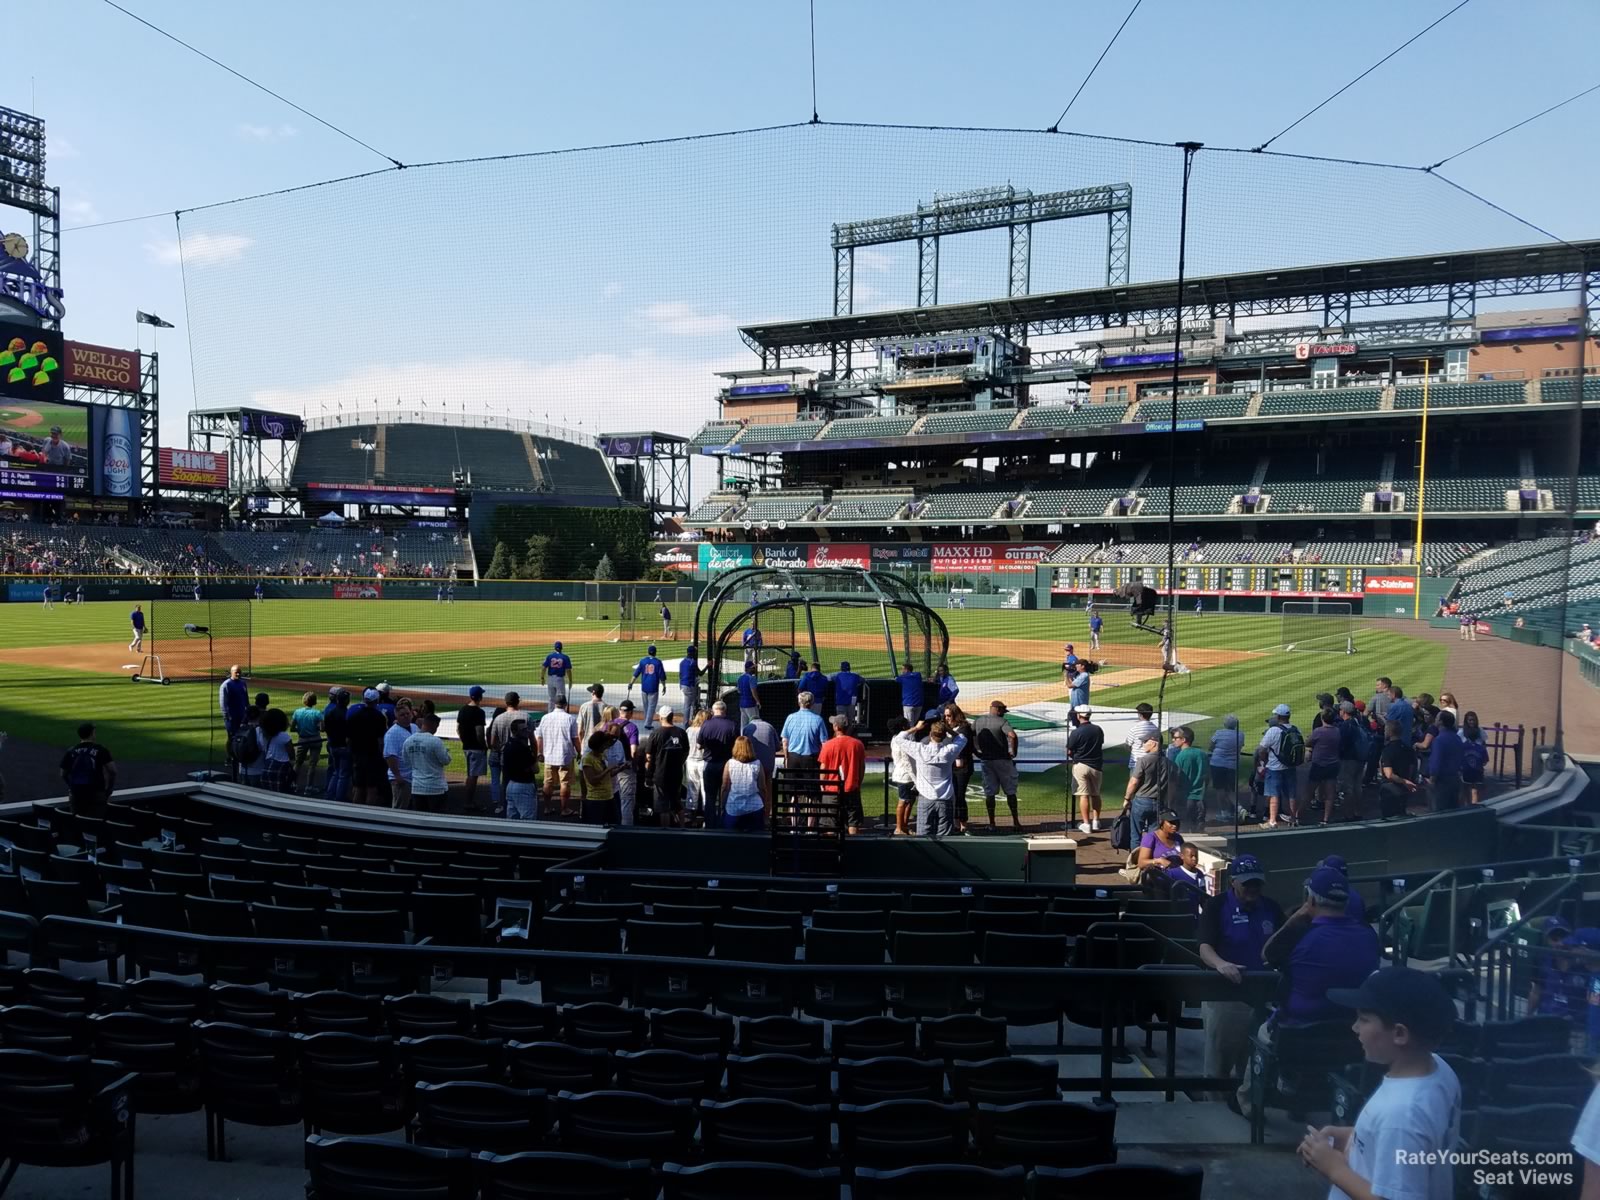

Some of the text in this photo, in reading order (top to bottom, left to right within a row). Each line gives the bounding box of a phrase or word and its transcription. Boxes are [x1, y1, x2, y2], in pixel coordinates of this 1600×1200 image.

[72, 348, 130, 370] WELLS
[73, 363, 130, 384] FARGO
[171, 451, 216, 471] KING
[107, 467, 127, 475] LIGHT
[765, 546, 798, 557] Bank of
[872, 547, 928, 559] Exxon Mobil
[933, 547, 993, 557] MAXX HD
[1005, 551, 1041, 560] OUTBA
[654, 552, 692, 563] Safelite
[765, 558, 806, 568] Colorado
